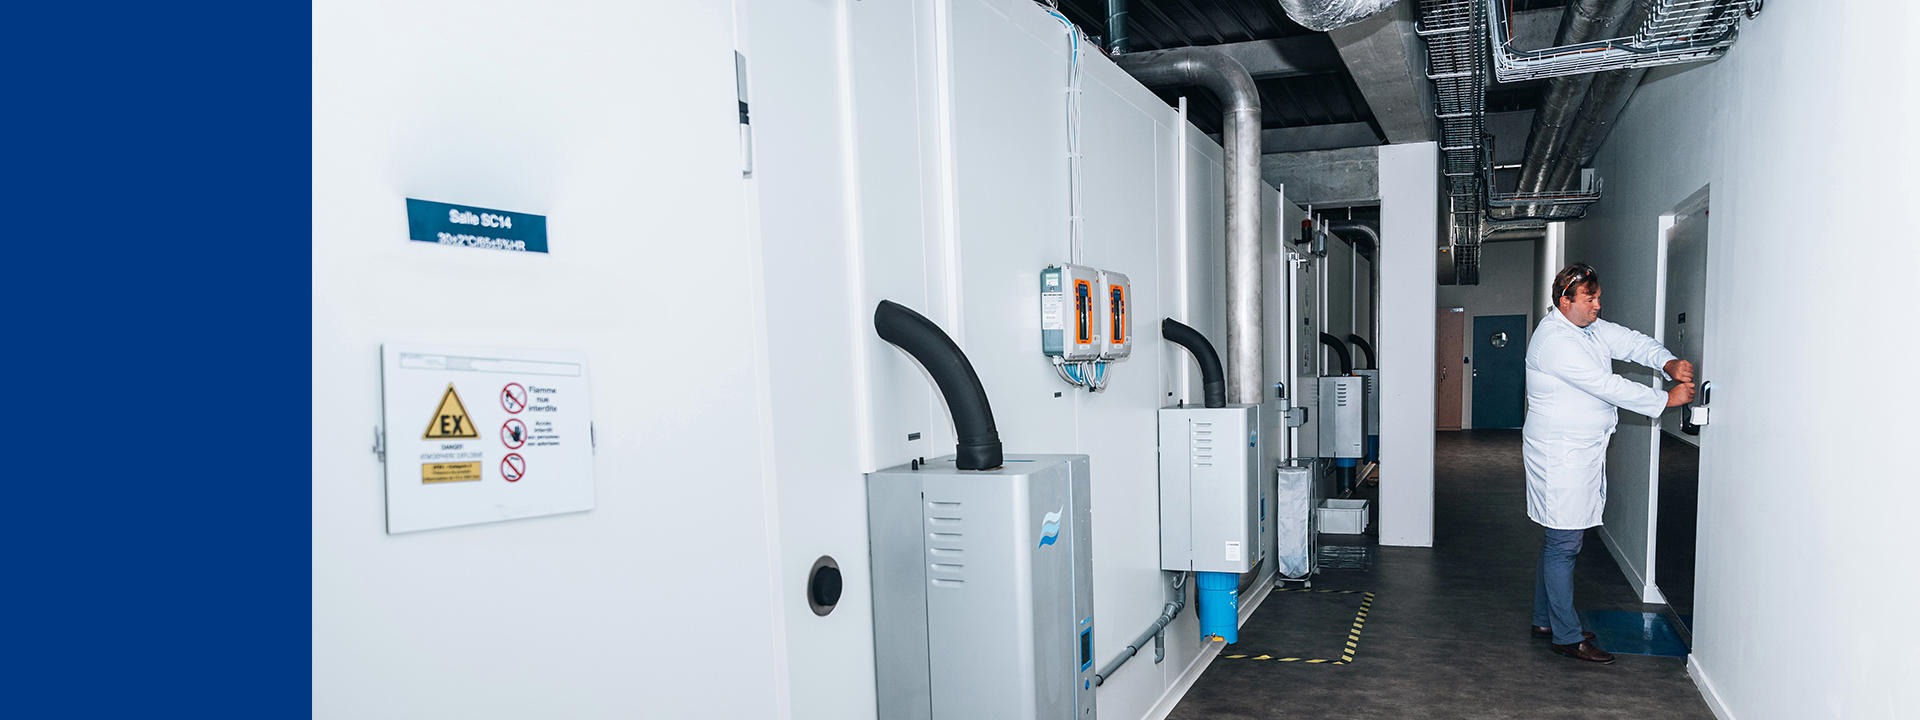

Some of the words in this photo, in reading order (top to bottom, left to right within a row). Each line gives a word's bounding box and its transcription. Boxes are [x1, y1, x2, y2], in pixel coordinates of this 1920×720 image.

[448, 208, 480, 226] Salle
[480, 212, 512, 229] SC14
[440, 415, 463, 434] EX
